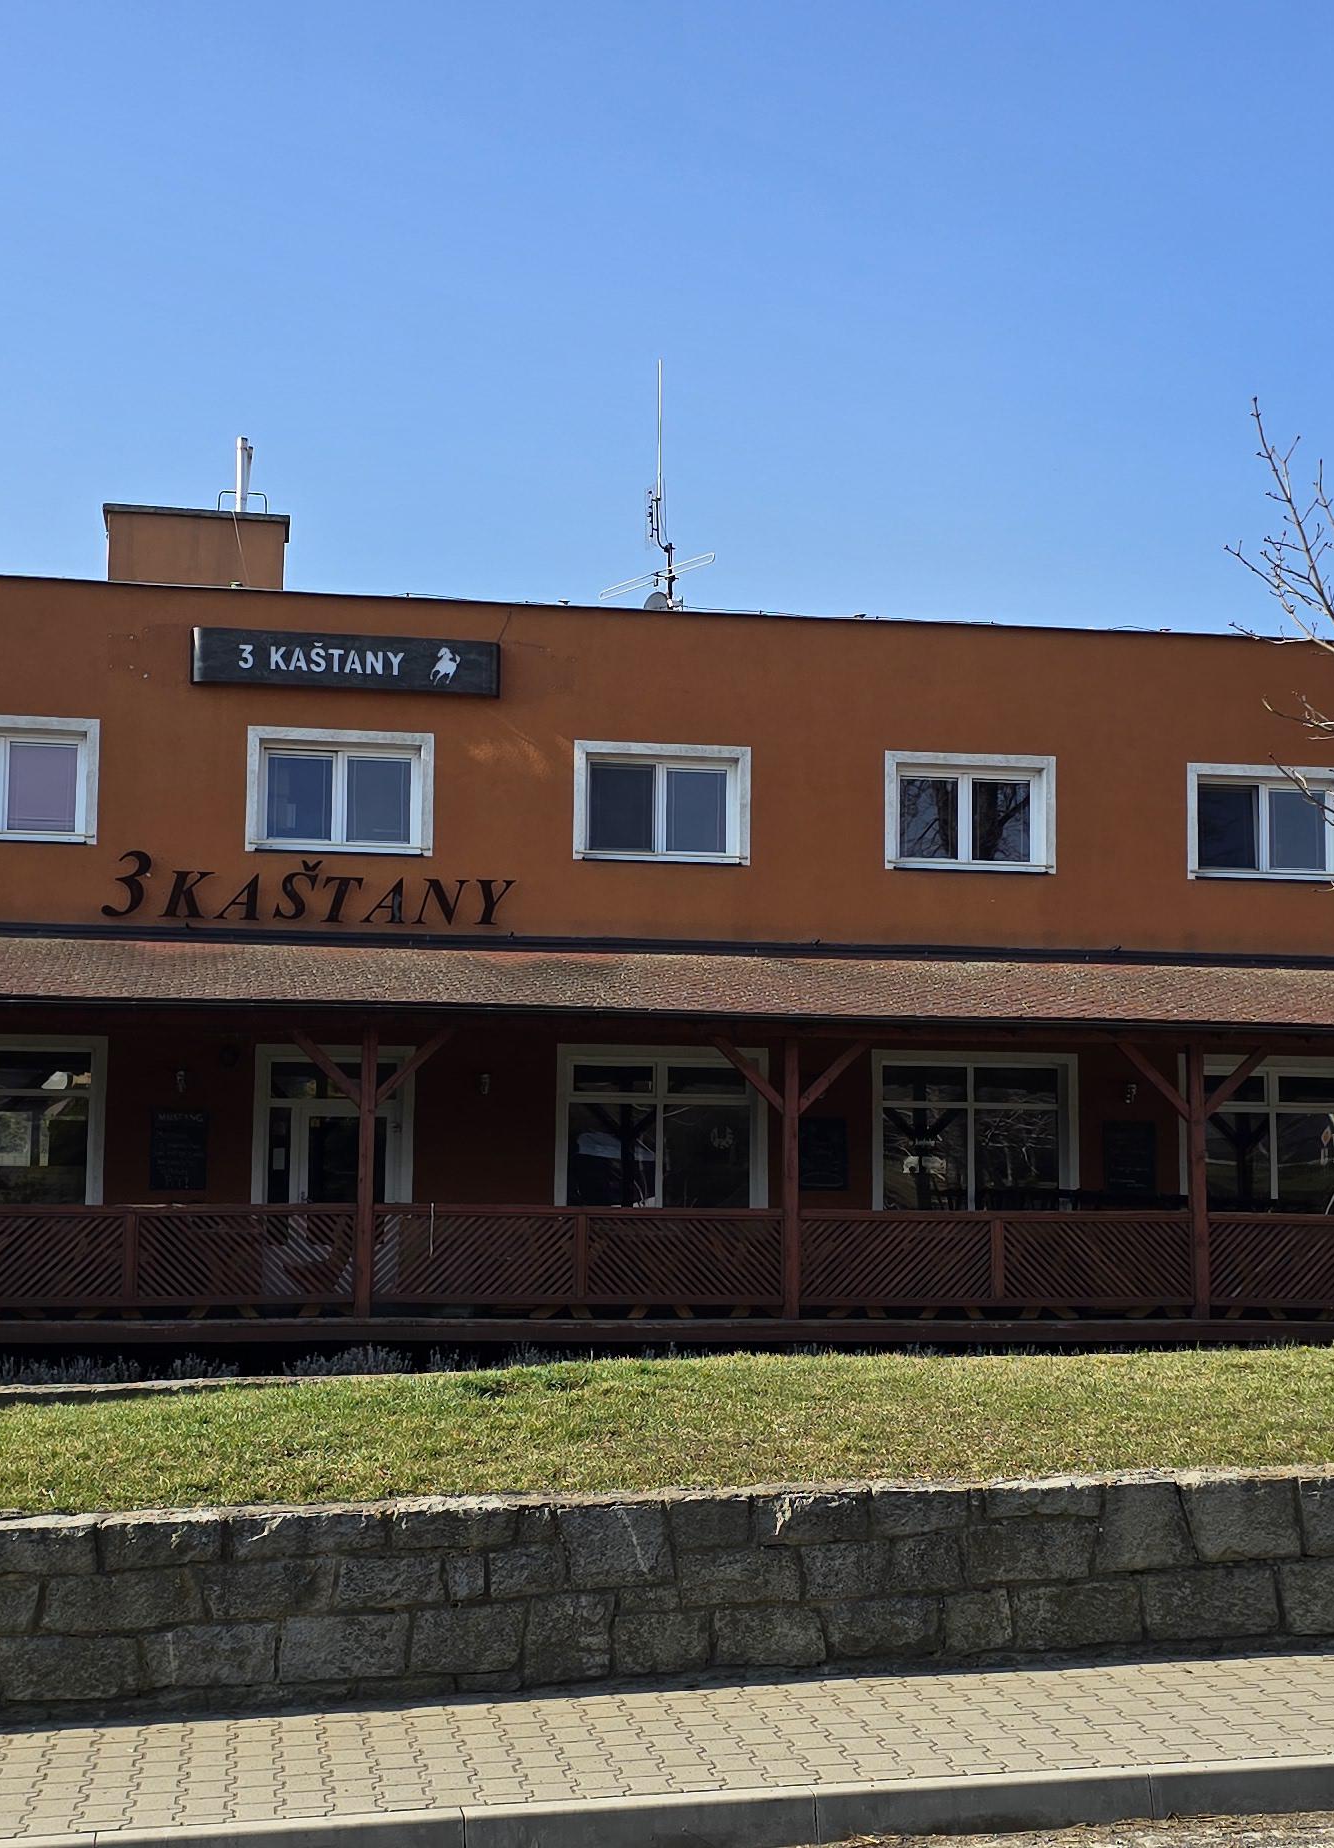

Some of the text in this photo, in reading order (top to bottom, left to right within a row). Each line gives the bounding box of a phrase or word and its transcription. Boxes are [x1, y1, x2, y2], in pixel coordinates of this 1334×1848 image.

[238, 642, 405, 676] 3 KAŠTANY
[101, 850, 517, 926] 3 KAŠTANY
